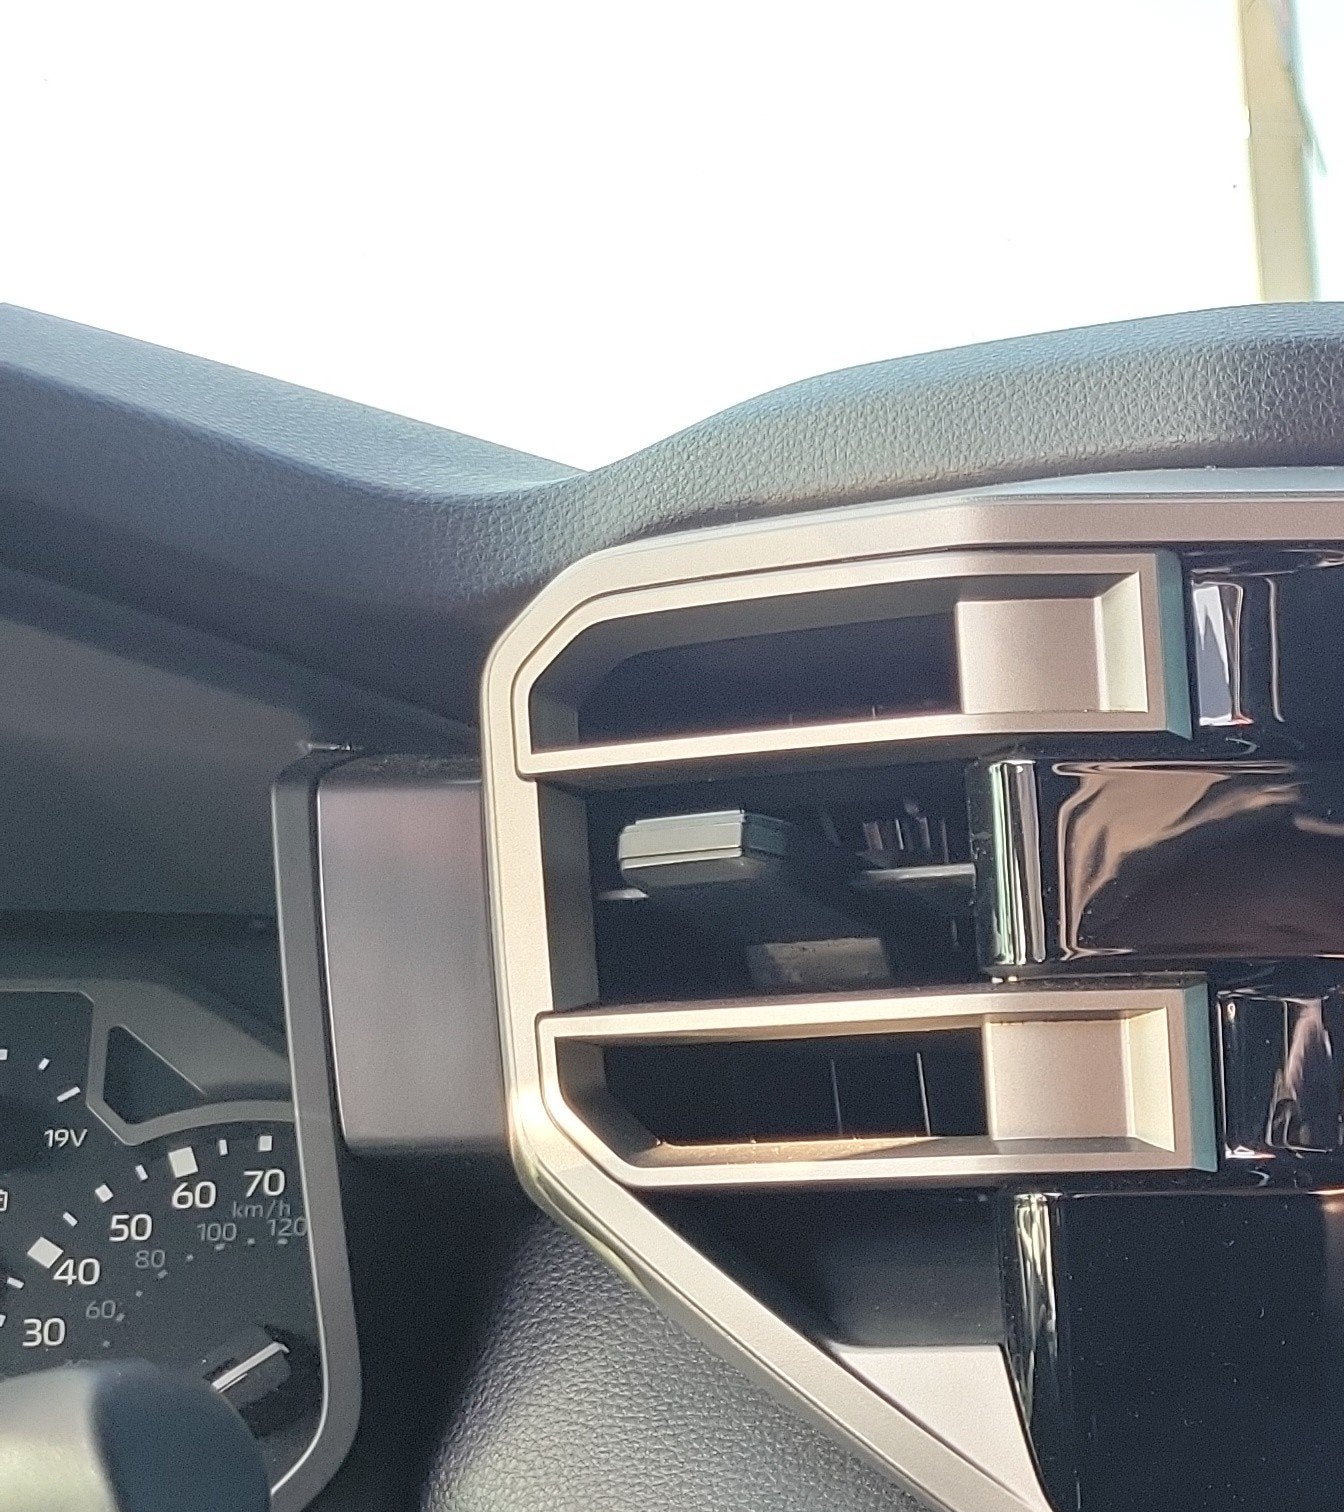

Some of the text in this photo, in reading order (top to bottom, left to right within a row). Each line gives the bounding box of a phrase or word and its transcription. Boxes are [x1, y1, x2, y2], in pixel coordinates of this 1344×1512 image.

[43, 1127, 88, 1148] 19V
[243, 1168, 286, 1198] 70
[171, 1181, 217, 1210] 60
[232, 1200, 291, 1219] km/h
[108, 1213, 153, 1242] 50
[197, 1222, 238, 1241] 100
[266, 1216, 308, 1237] 120
[135, 1249, 166, 1268] 80
[53, 1257, 100, 1286] 40
[85, 1300, 117, 1319] 60
[22, 1317, 66, 1347] 30
